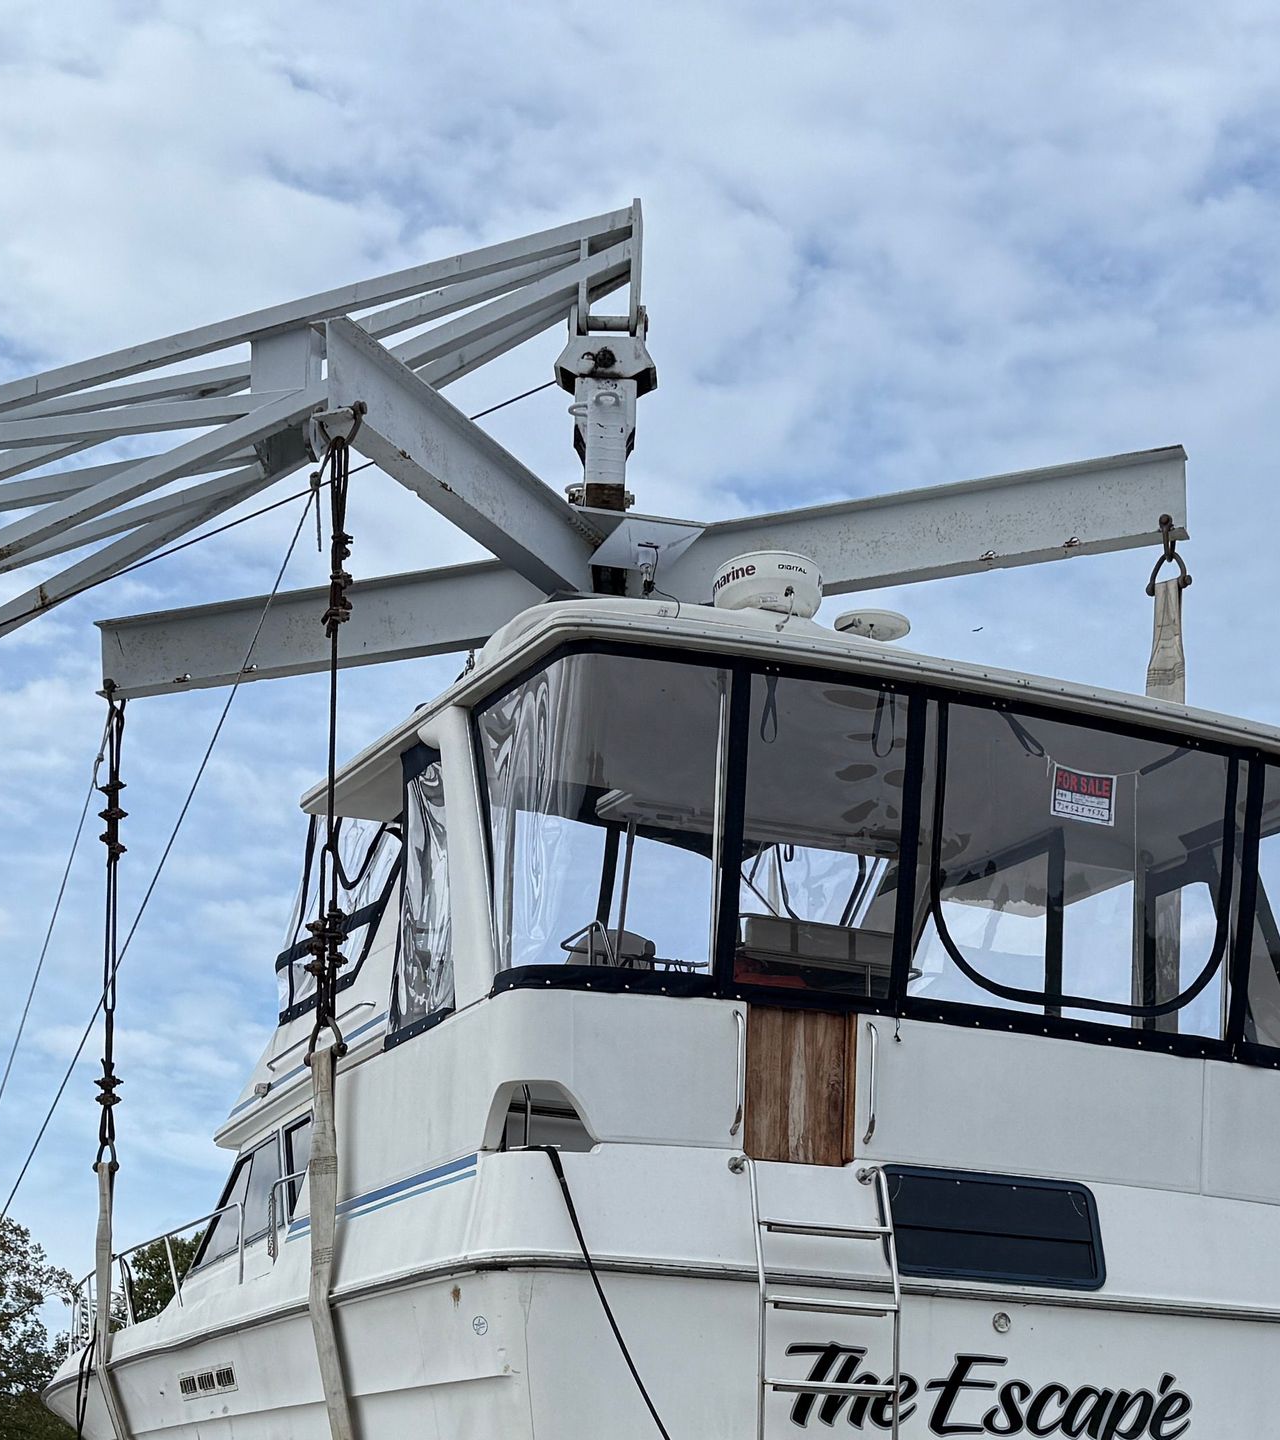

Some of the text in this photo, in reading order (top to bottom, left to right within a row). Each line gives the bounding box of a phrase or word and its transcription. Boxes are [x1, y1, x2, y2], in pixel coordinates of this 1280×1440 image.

[778, 563, 808, 575] DIGITAL
[1056, 769, 1111, 798] FOR SALE
[786, 1340, 919, 1431] The
